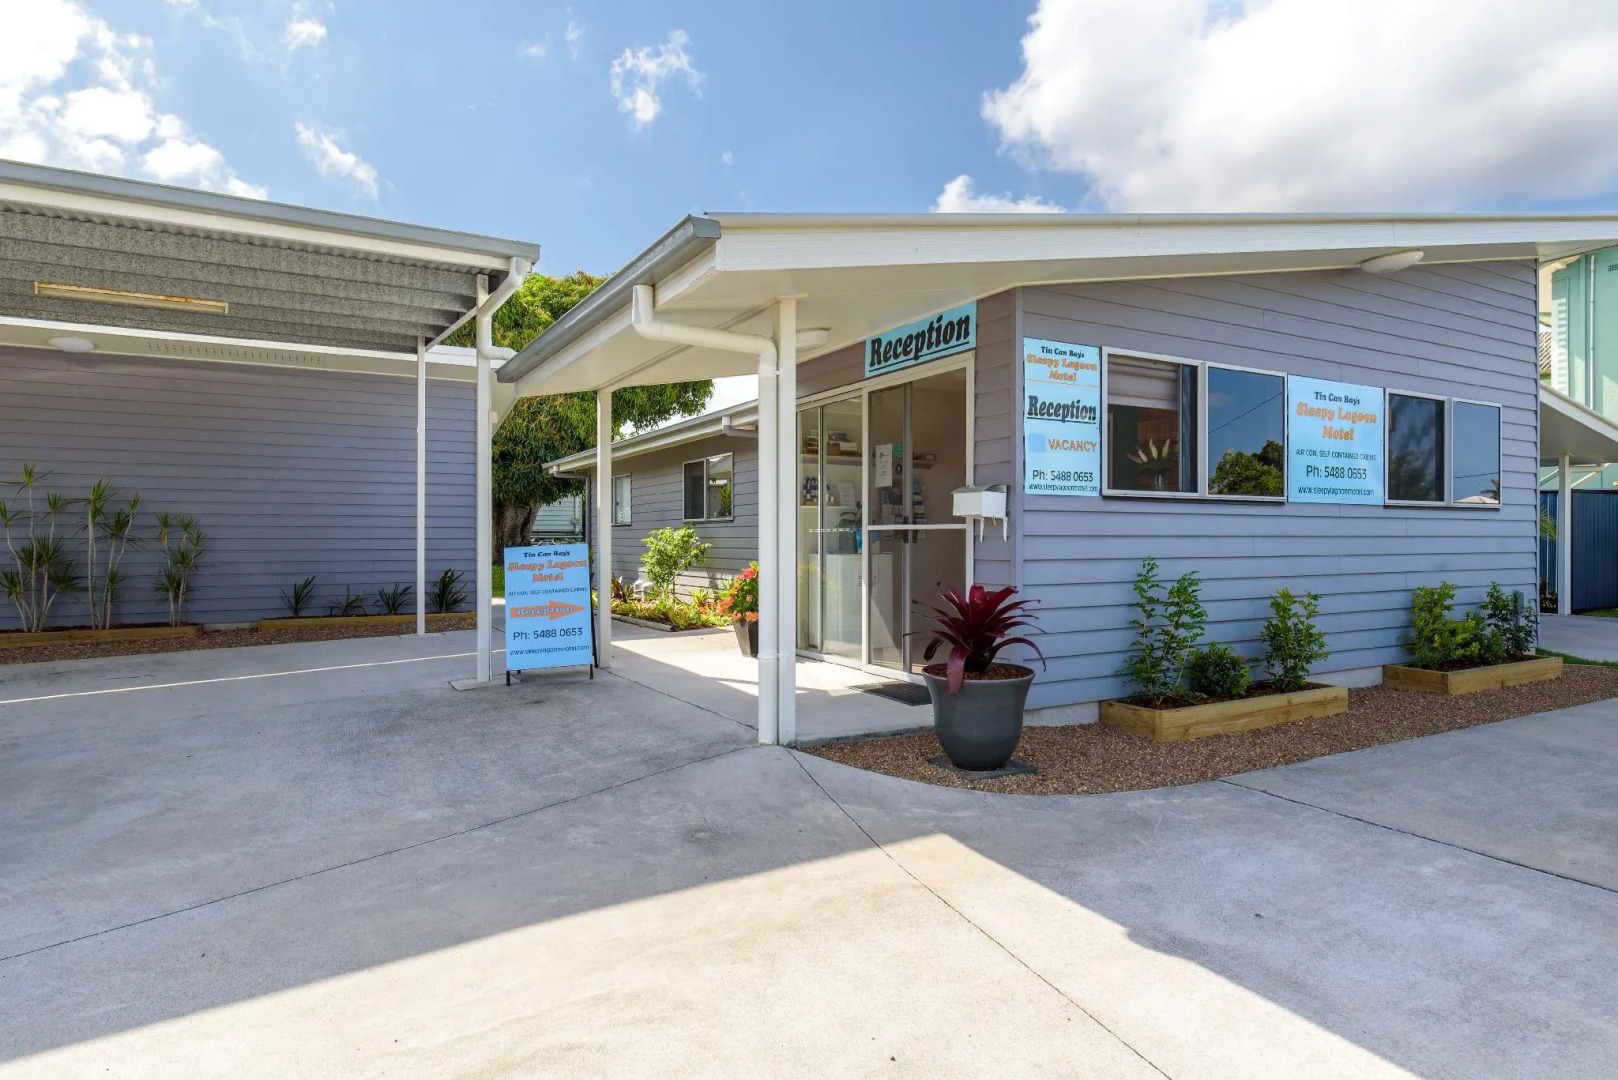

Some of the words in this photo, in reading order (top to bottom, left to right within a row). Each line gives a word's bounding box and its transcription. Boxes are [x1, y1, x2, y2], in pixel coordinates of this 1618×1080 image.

[869, 314, 971, 368] Reception
[1041, 346, 1053, 354] Tin
[1054, 348, 1067, 356] Can
[1026, 353, 1060, 368] Sleepy
[1062, 357, 1098, 371] Lagoon
[1049, 369, 1077, 382] Motel
[1314, 391, 1327, 401] Tin
[1328, 393, 1343, 403] Can
[1027, 395, 1097, 423] Reception
[1296, 401, 1335, 421] Sleepy
[1337, 407, 1377, 424] Lagoon
[1322, 425, 1354, 441] Motel
[1048, 438, 1098, 453] VACANCY
[1295, 448, 1305, 456] AIR
[1319, 450, 1331, 458] SELF
[1331, 451, 1359, 460] CONTAINED
[1032, 469, 1048, 481] Ph:
[1050, 470, 1072, 482] 5488
[1073, 471, 1094, 482] 0653
[1306, 465, 1322, 478] Ph:
[1324, 466, 1345, 479] 5488
[1347, 467, 1367, 480] 0653
[507, 561, 545, 571] Sleepy
[546, 559, 587, 569] Lagoon
[531, 571, 564, 583] Motel
[516, 606, 573, 615] Reception
[513, 631, 530, 640] Ph:
[533, 629, 557, 639] 5488
[559, 627, 583, 637] 0653
